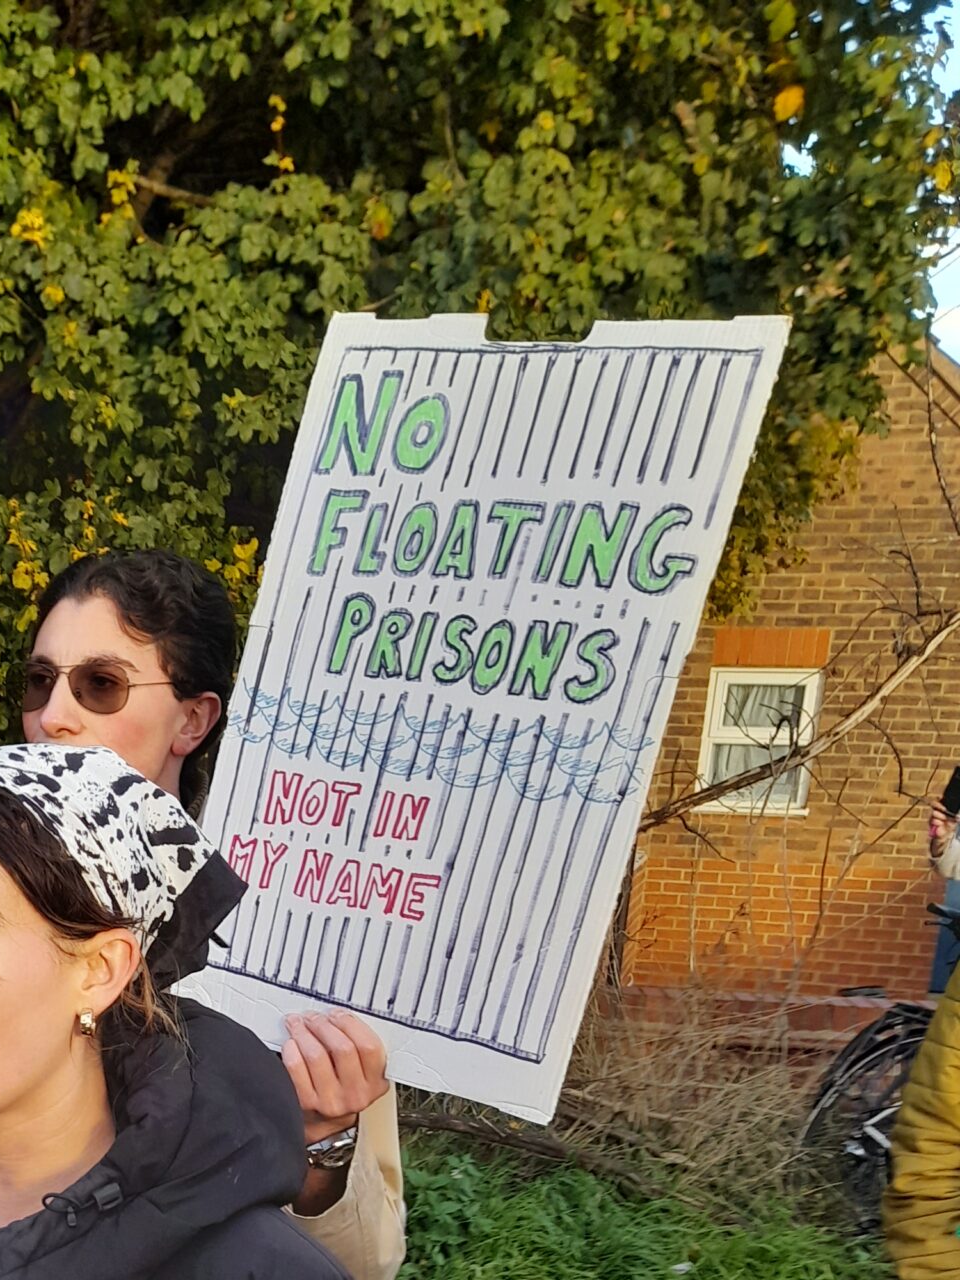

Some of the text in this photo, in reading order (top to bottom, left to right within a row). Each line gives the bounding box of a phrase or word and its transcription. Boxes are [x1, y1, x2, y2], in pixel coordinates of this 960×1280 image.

[314, 369, 450, 476] NO
[307, 488, 699, 595] FLOATING
[327, 591, 620, 704] PRISONS
[263, 768, 431, 841] NOT IN
[227, 834, 442, 922] MY NAME
